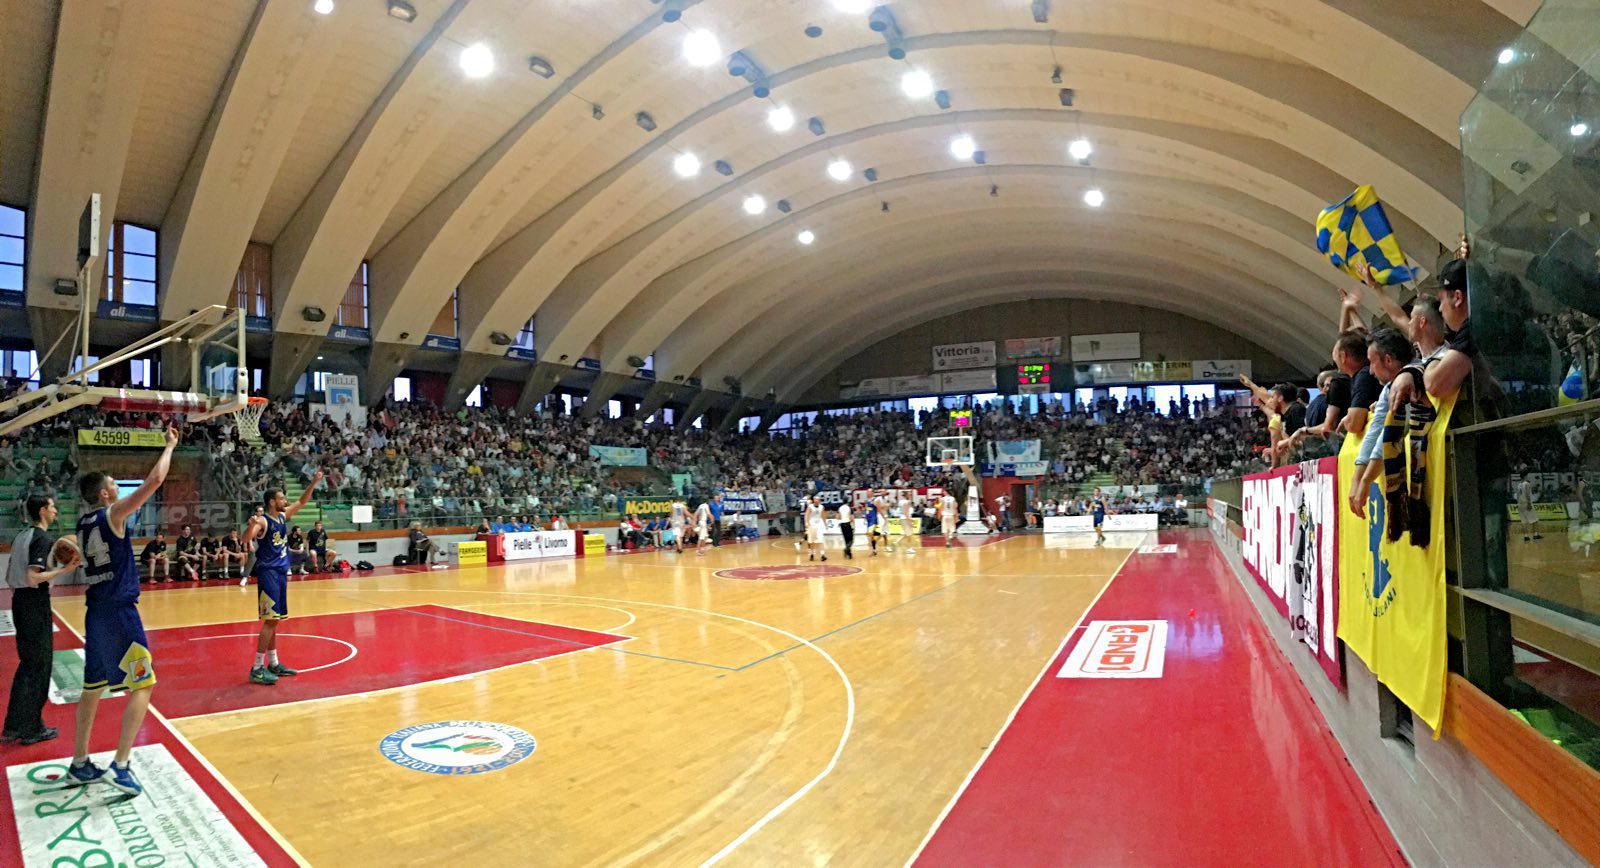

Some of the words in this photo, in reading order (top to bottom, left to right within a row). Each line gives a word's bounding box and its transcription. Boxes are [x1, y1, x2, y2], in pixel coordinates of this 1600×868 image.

[110, 306, 126, 317] ali
[935, 345, 981, 357] Vittoria
[326, 376, 356, 385] PIELLE
[93, 431, 130, 445] 45599
[625, 500, 688, 515] McDona
[513, 538, 533, 551] Pielle
[543, 537, 568, 549] Livorno
[1243, 474, 1336, 664] SBANDAI
